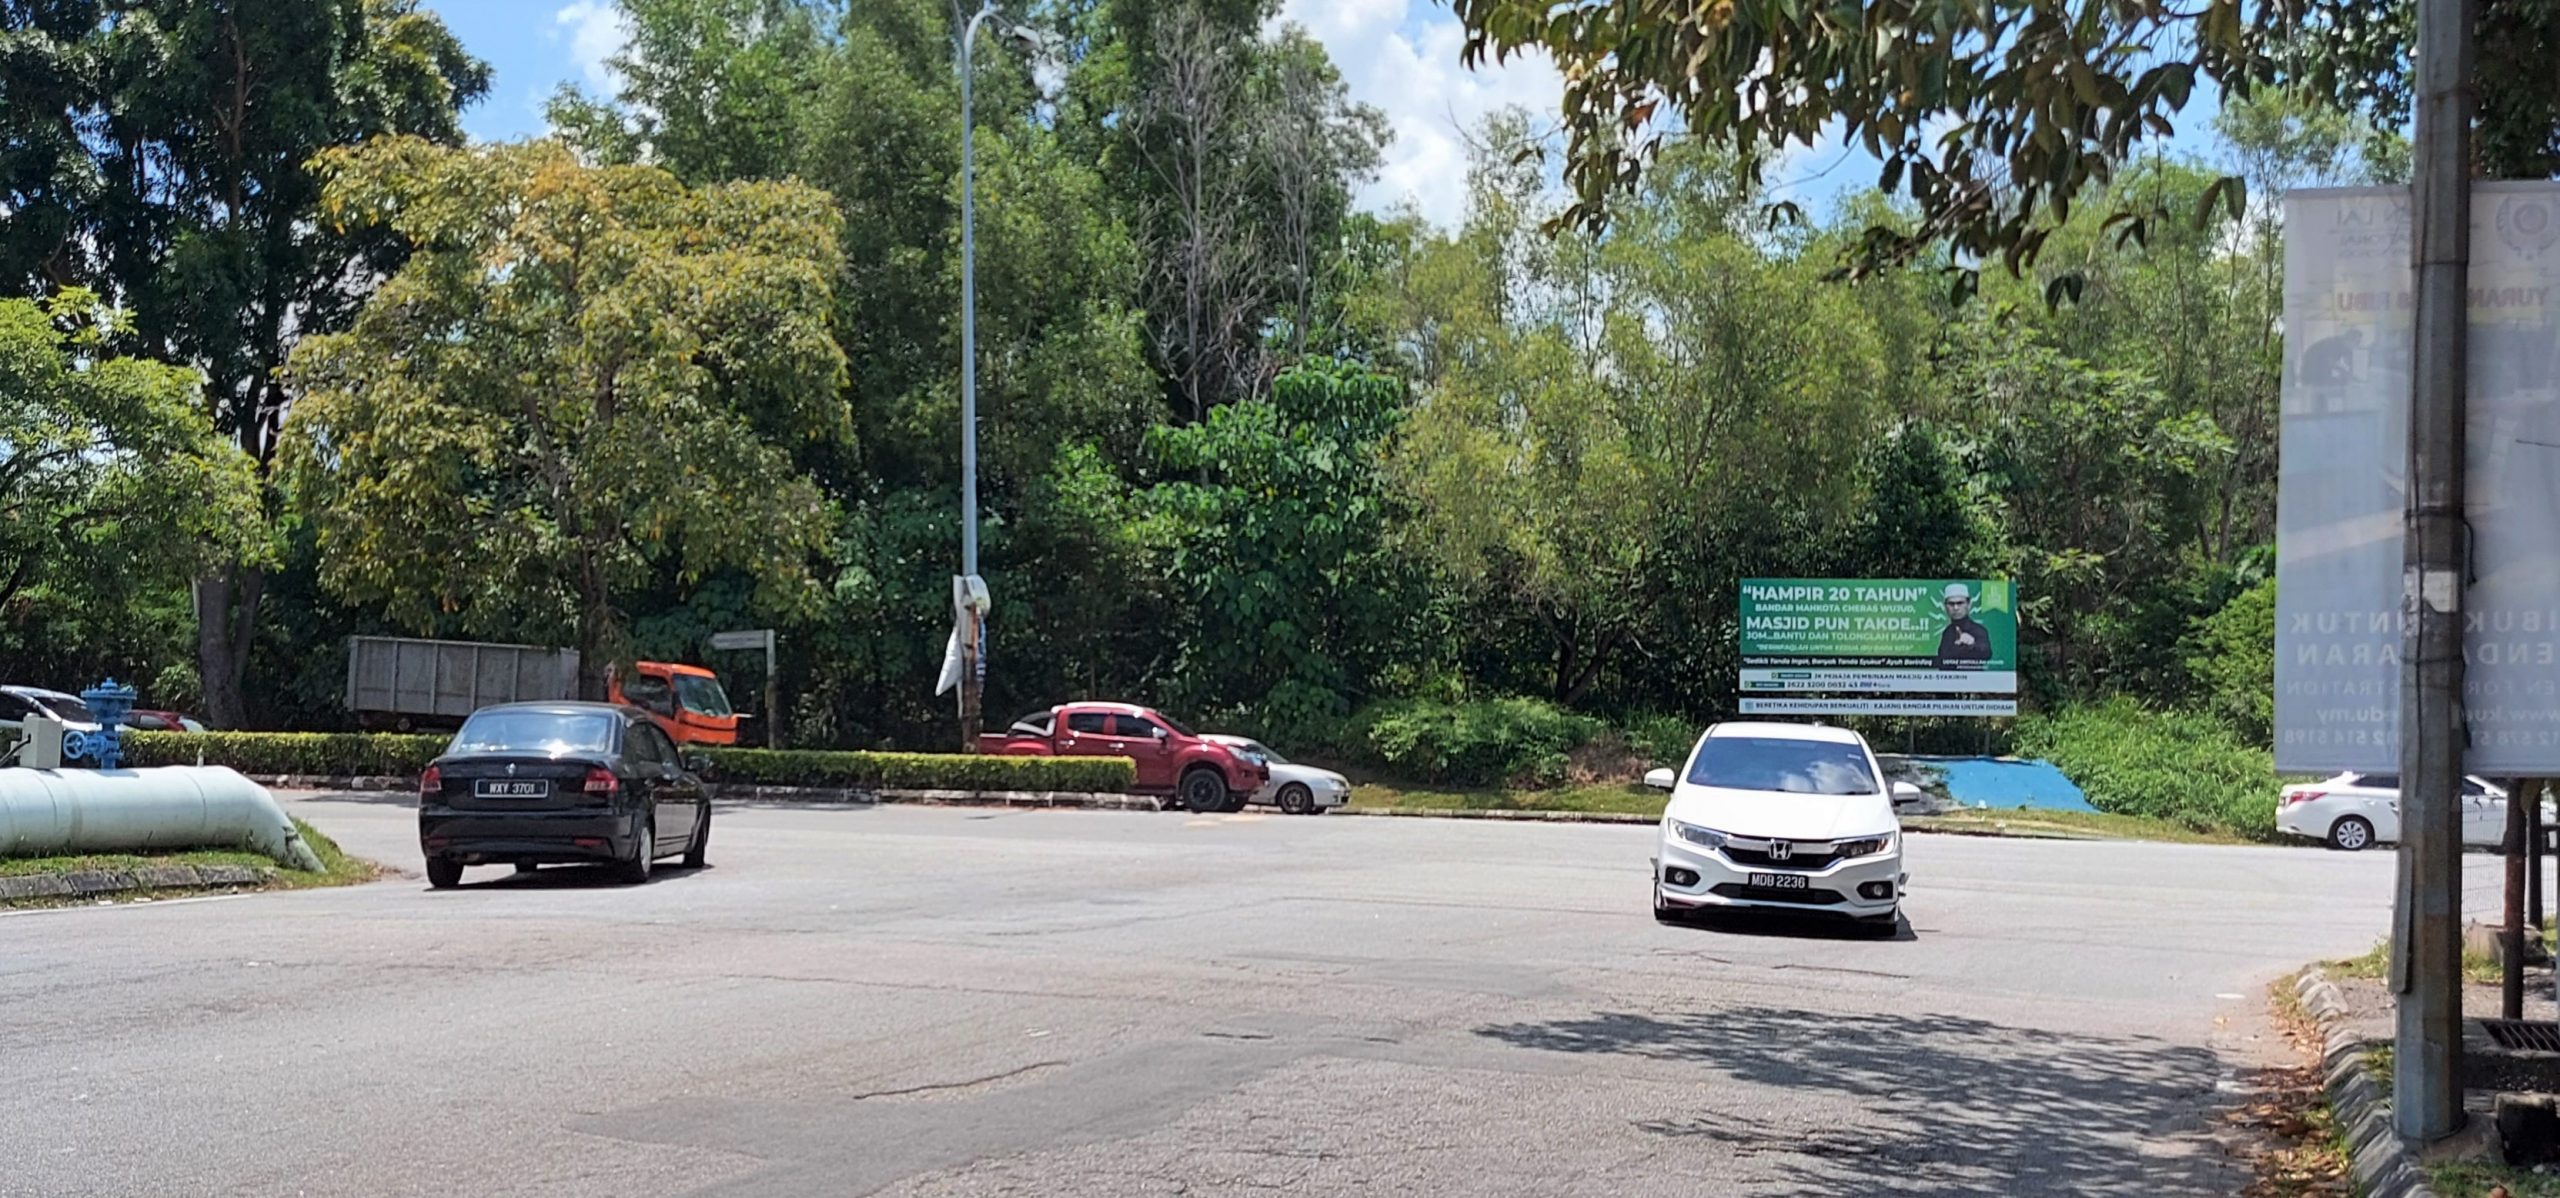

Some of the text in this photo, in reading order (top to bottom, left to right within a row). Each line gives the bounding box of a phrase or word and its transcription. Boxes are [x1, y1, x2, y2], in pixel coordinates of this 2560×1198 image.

[1828, 587, 1850, 602] 20
[1755, 604, 1916, 614] BANDAR MAHKOTA CHERAS WUJUD,
[1746, 617, 1929, 631] MASJID PUN TAKDE..!!
[1808, 632, 1829, 640] DAN
[1831, 632, 1889, 641] TOLONGLAH
[512, 783, 534, 794] 3701
[1751, 874, 1806, 888] MDB 2236
